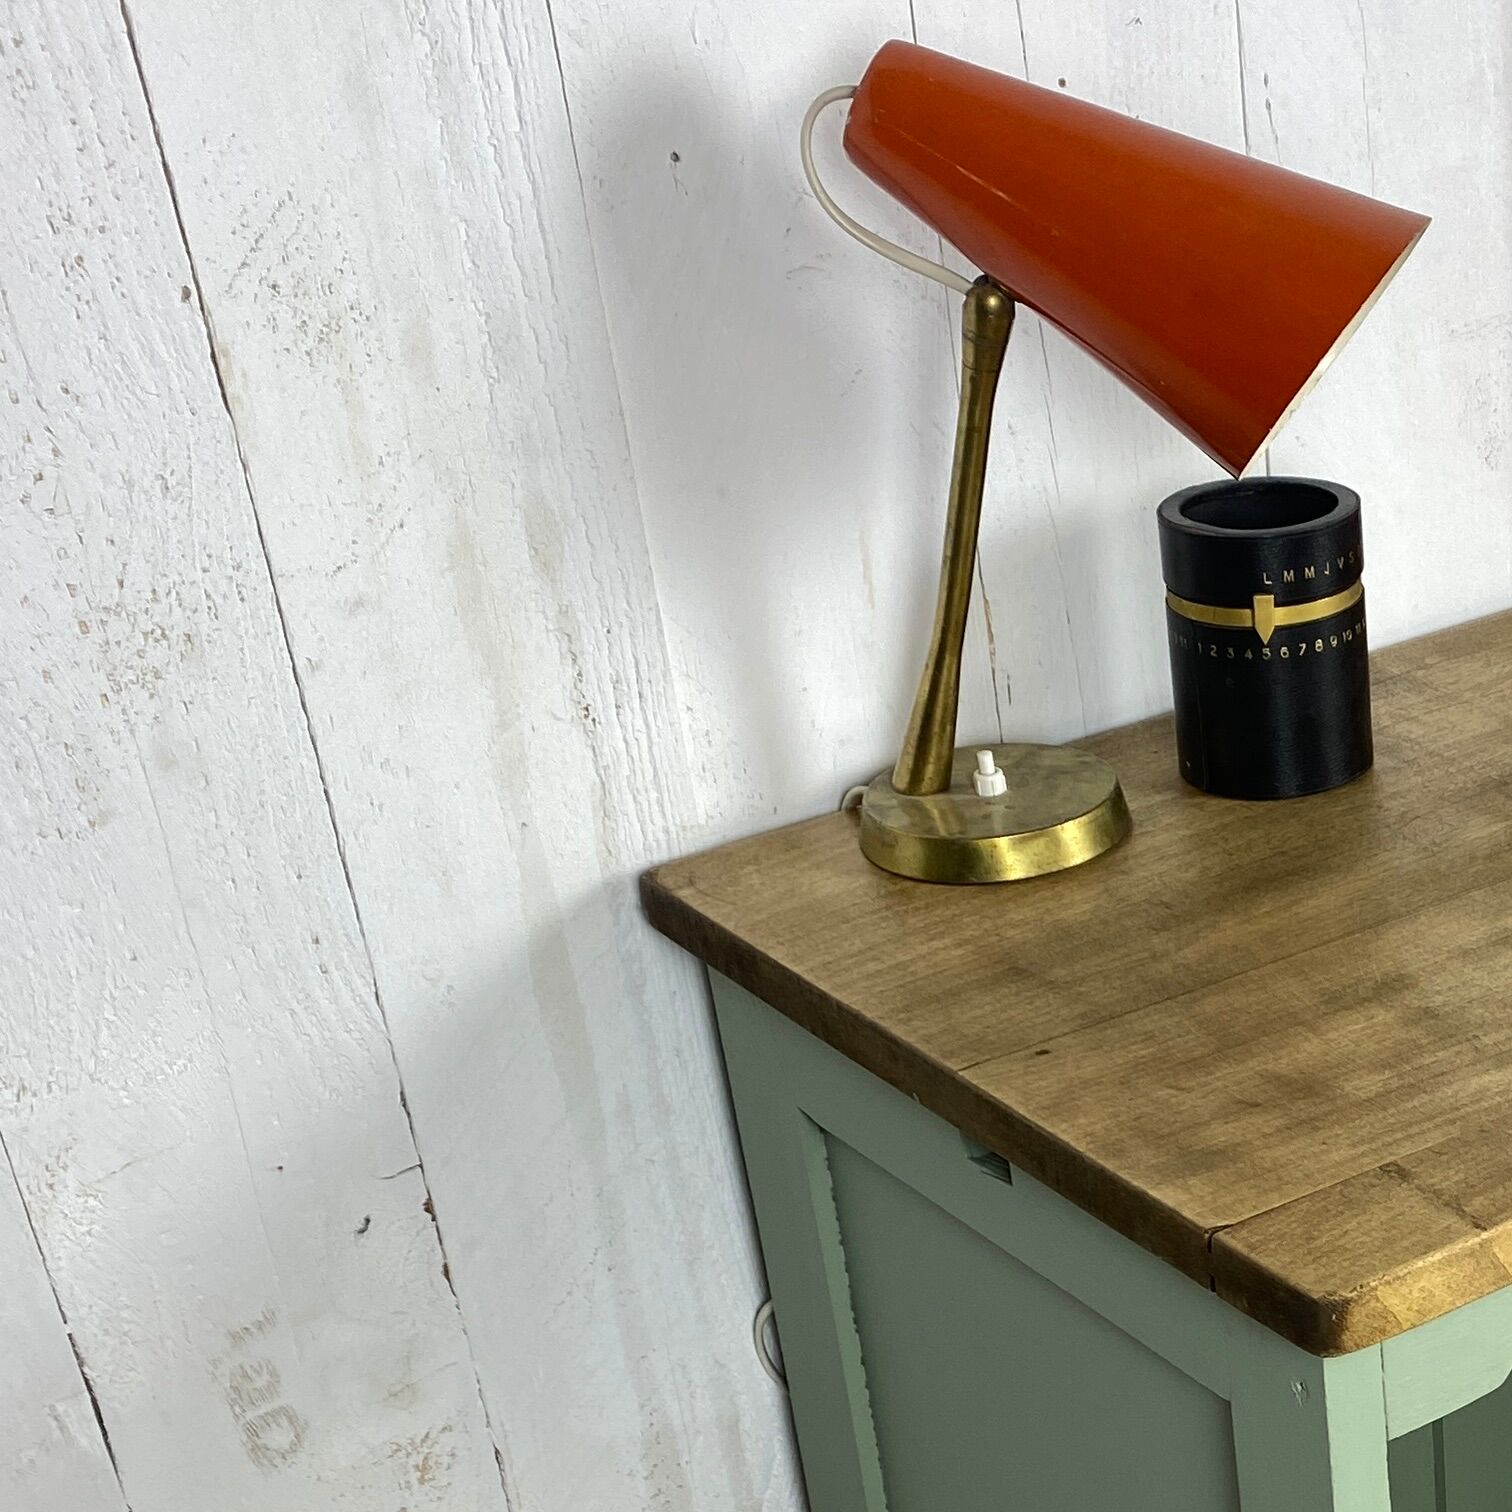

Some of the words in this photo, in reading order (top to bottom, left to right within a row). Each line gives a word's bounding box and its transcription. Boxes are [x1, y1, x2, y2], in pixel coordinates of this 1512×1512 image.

[1262, 572, 1273, 585] L
[1283, 569, 1295, 583] M
[1304, 565, 1316, 579] M
[1323, 561, 1330, 575] J
[1336, 556, 1345, 570] V
[1348, 551, 1356, 564] S
[1209, 644, 1218, 658] 2
[1226, 647, 1235, 659] 3
[1244, 648, 1254, 660] 4
[1261, 647, 1272, 660] 5
[1280, 646, 1290, 659] 6
[1298, 642, 1307, 657] 7
[1314, 638, 1324, 653] 8
[1329, 635, 1338, 648] 9
[1342, 628, 1353, 644] 10
